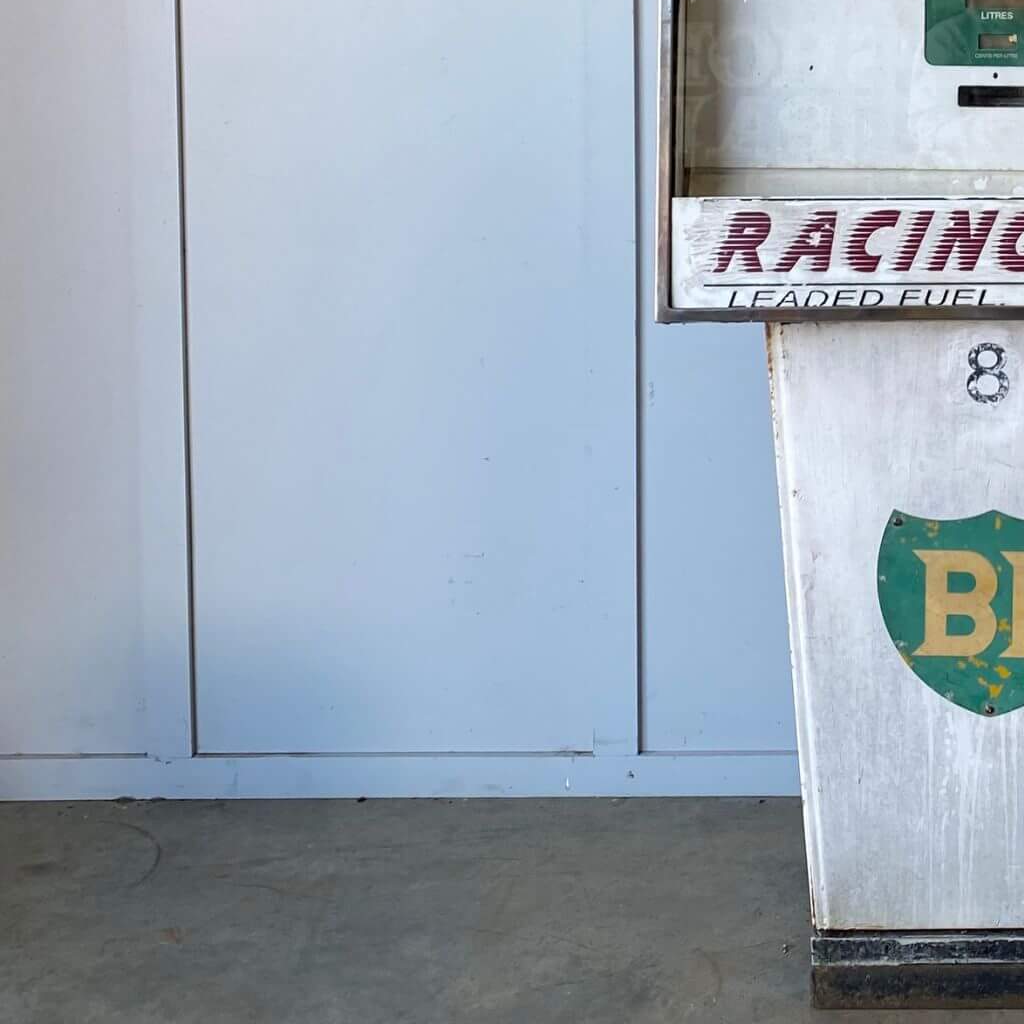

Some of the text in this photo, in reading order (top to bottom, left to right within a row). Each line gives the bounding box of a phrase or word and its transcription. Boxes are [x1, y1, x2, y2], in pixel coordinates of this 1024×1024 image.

[980, 11, 1014, 20] LITRES
[727, 289, 884, 307] LEADED
[966, 342, 1010, 404] 8
